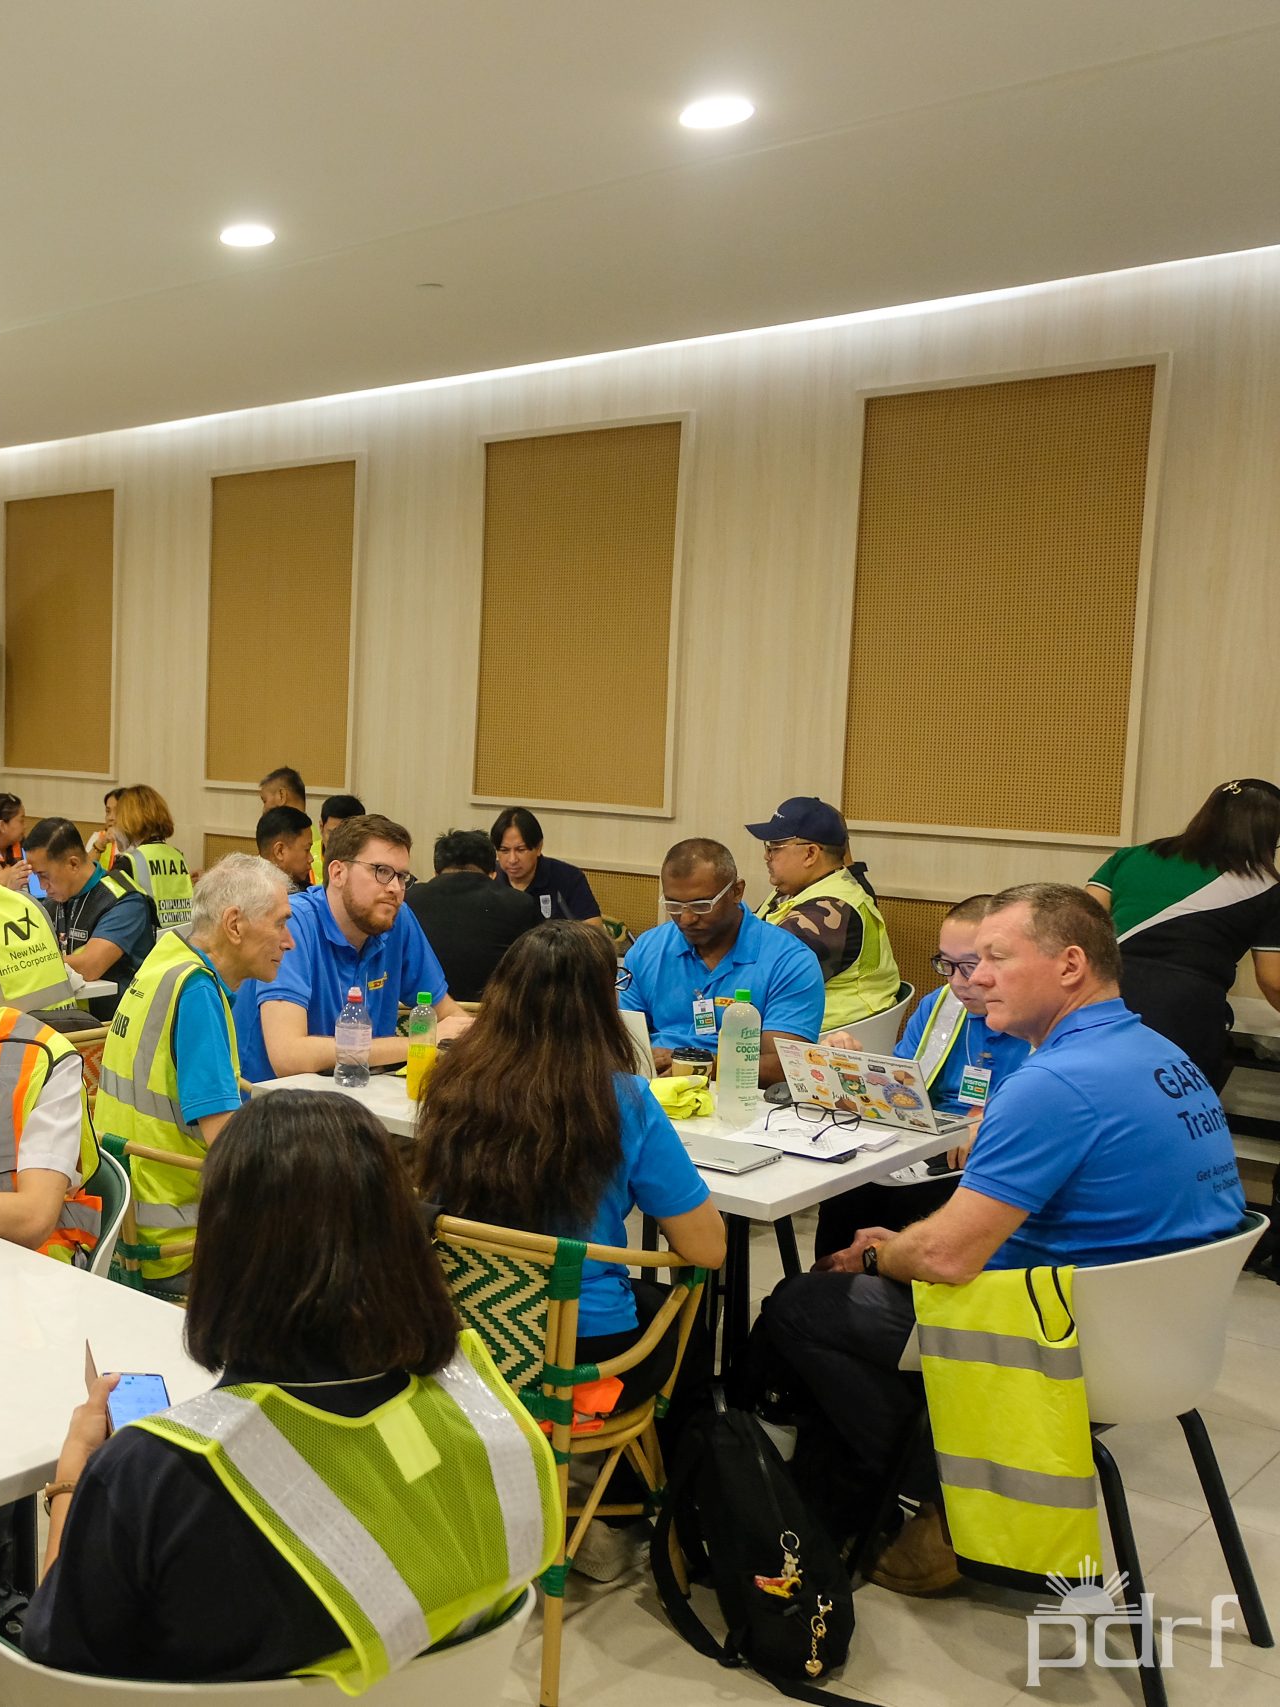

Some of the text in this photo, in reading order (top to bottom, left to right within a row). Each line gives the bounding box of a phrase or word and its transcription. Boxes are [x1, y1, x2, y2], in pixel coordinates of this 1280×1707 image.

[148, 859, 189, 876] MIAA
[9, 942, 48, 961] New NAIA
[1153, 1060, 1209, 1099] GAR
[1196, 1167, 1212, 1182] Get
